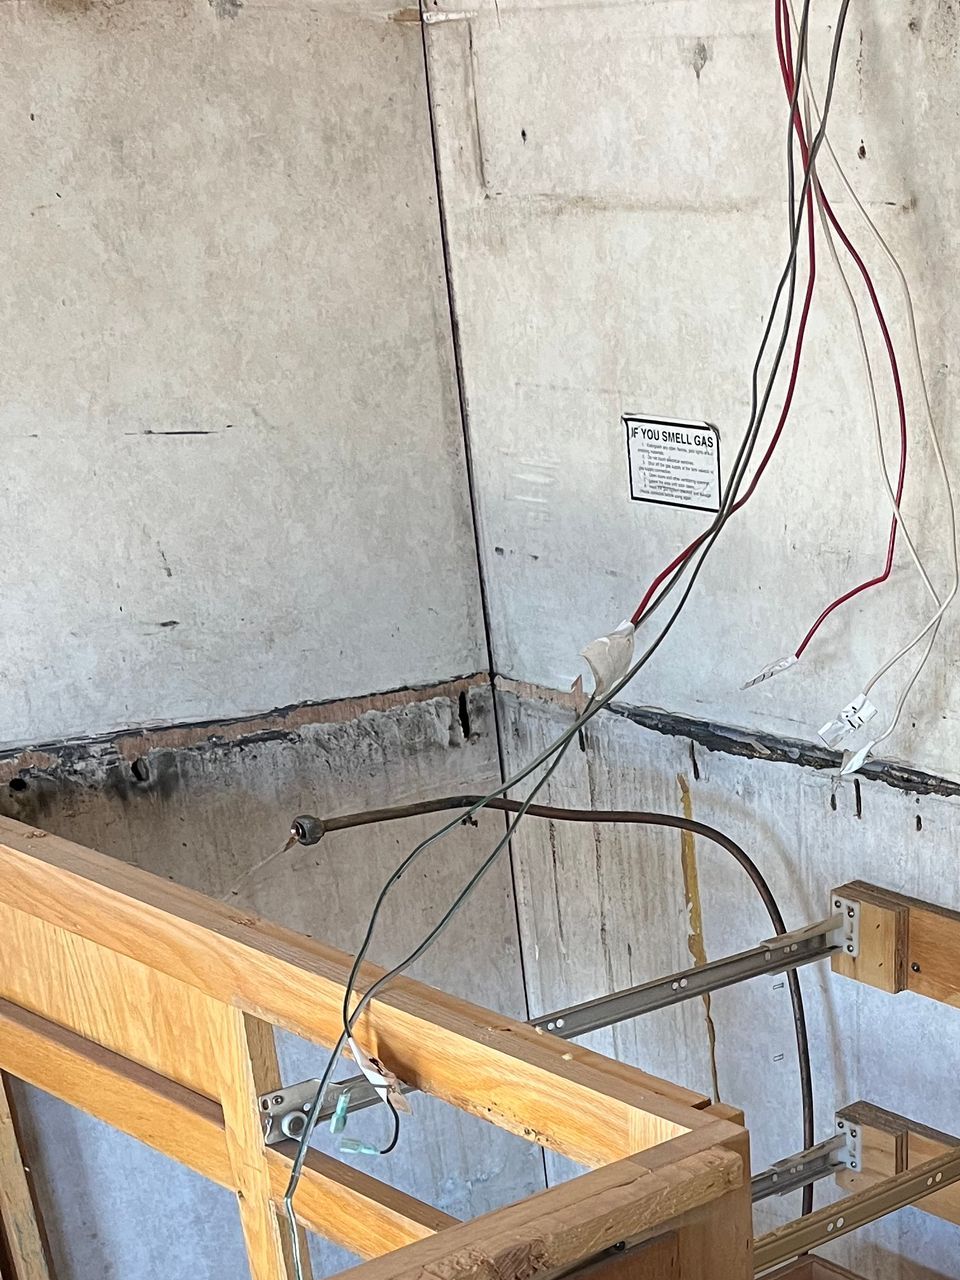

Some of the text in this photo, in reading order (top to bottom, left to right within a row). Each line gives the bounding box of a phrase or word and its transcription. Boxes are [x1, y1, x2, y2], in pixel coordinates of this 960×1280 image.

[631, 427, 714, 448] IF YOU SMELL GAS
